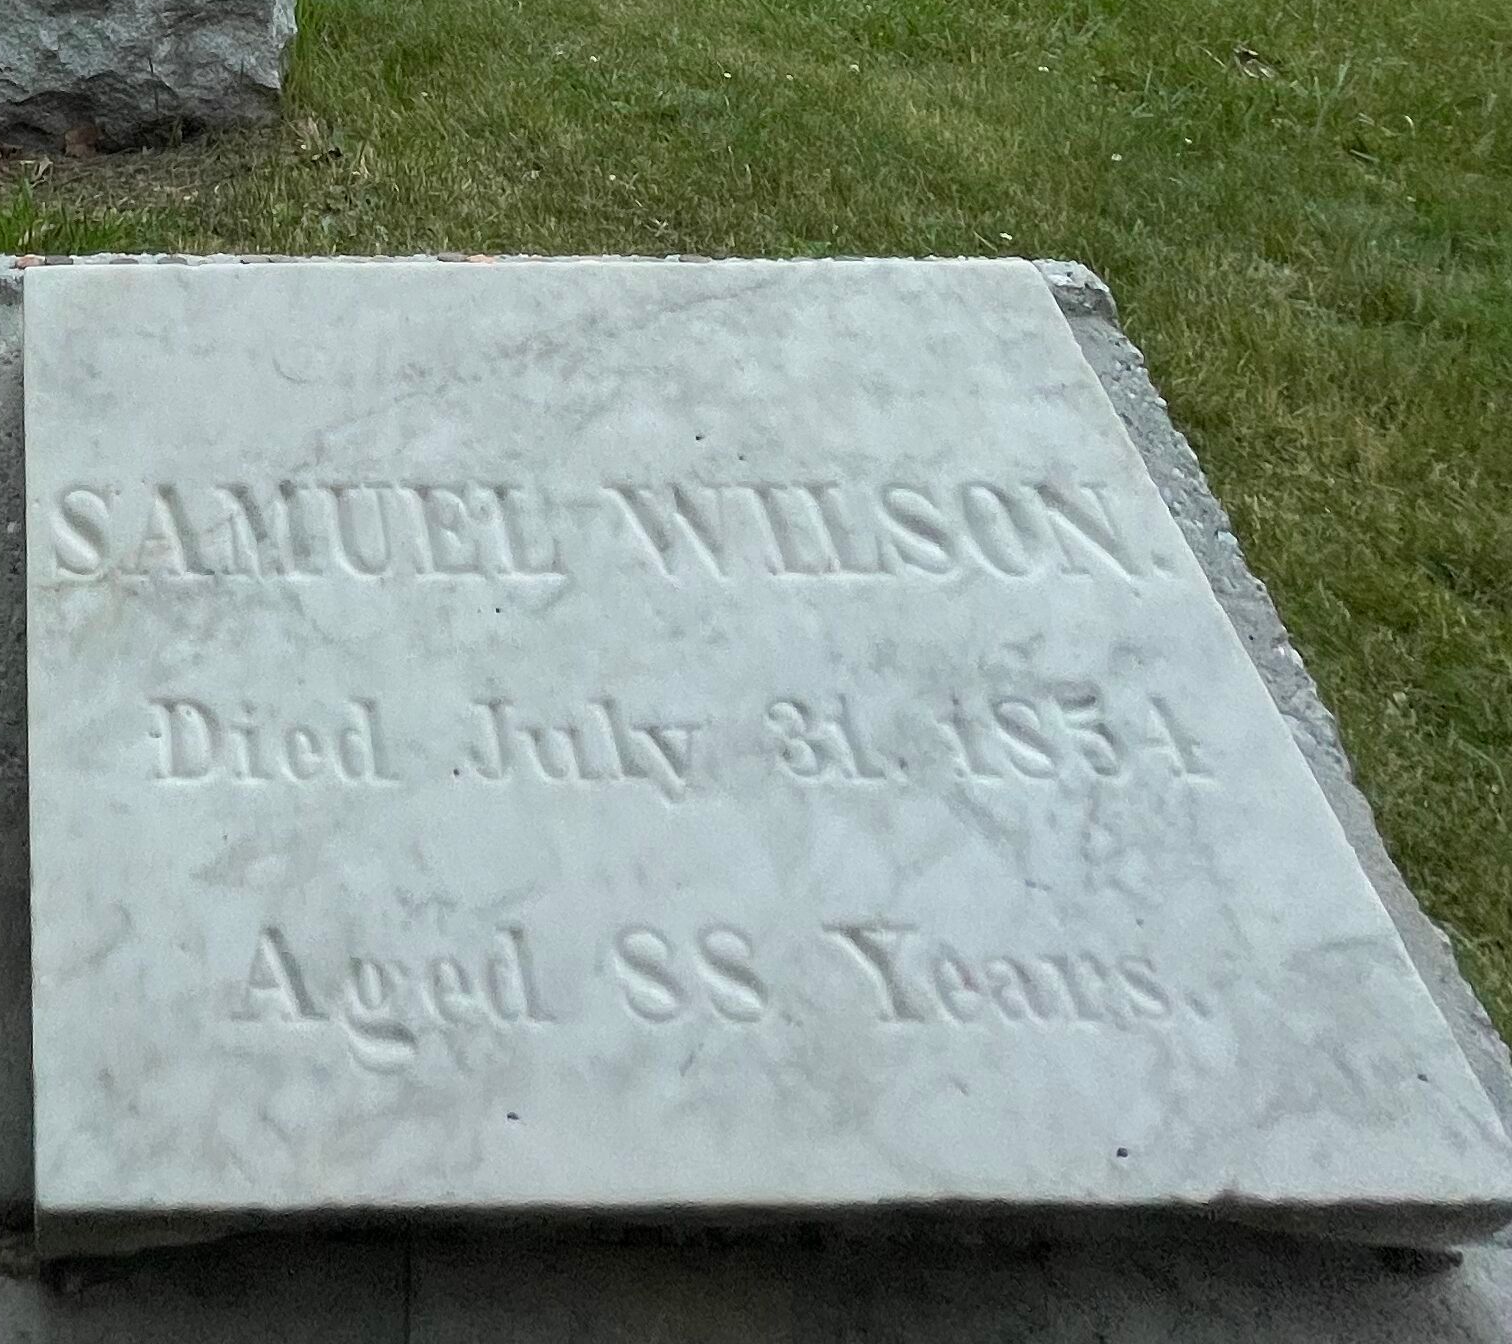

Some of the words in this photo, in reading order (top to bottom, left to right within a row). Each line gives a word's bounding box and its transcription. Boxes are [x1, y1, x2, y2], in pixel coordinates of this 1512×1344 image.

[51, 480, 574, 584] SAMUEL
[144, 692, 400, 788] Died
[464, 692, 704, 803] July
[938, 682, 1218, 790] 1854
[228, 924, 556, 1072] Aged
